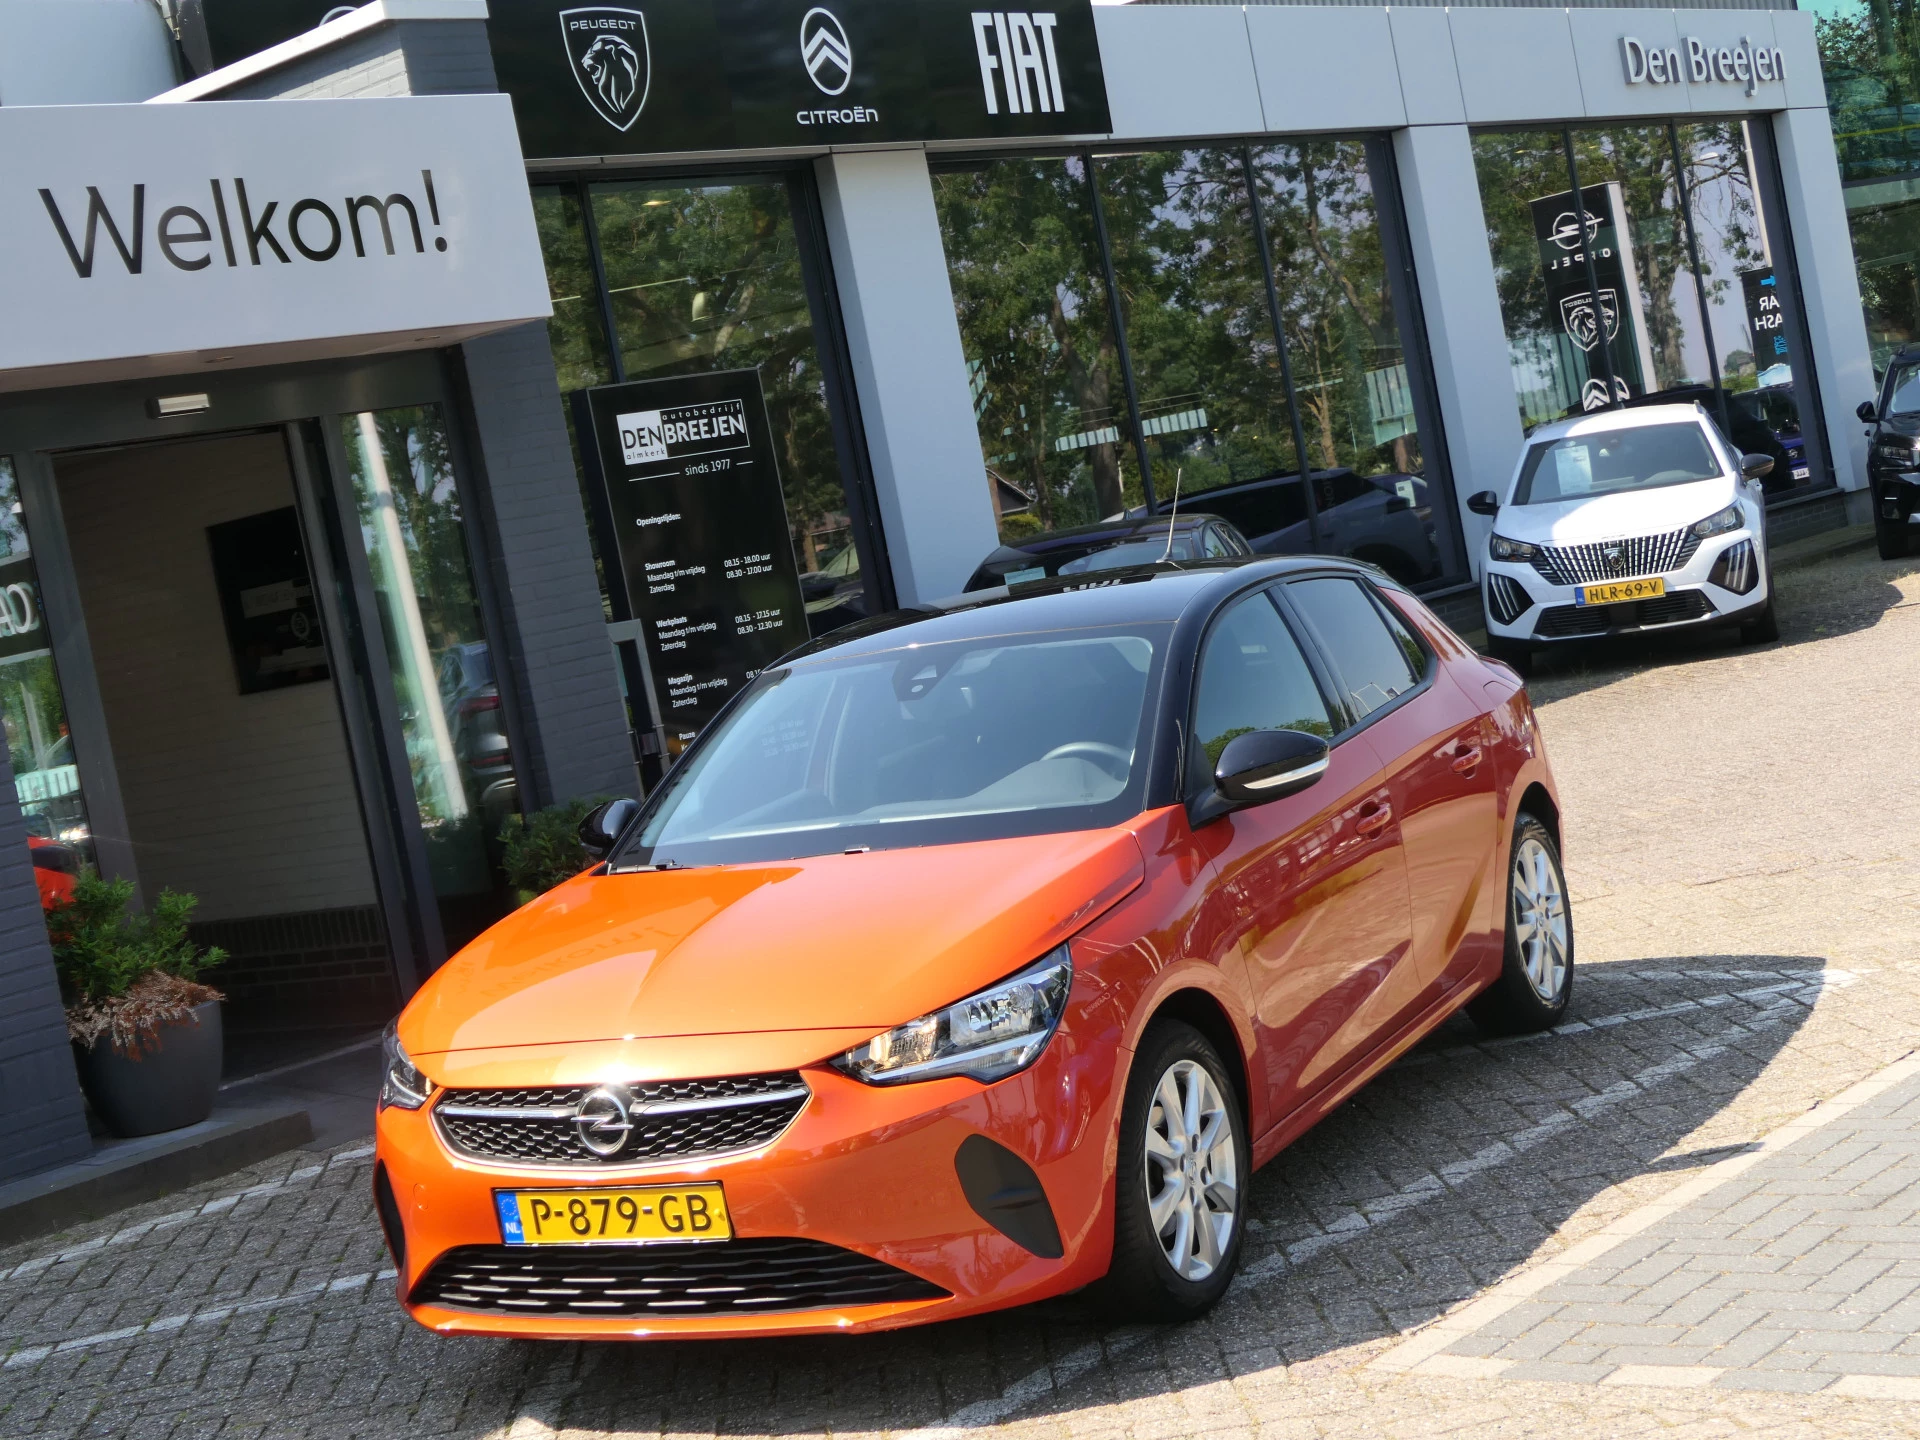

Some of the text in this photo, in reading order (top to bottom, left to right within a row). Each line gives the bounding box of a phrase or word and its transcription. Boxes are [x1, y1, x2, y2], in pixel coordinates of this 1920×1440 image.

[569, 18, 637, 31] PEUGEOT
[970, 12, 1065, 114] FIAT
[1618, 35, 1787, 98] Den Breejen
[37, 169, 449, 279] Welkom!
[662, 402, 741, 420] autobedrijf
[621, 413, 746, 450] DEN BREEJEN
[626, 449, 666, 461] almkerk
[684, 459, 731, 476] sinds 1977
[636, 514, 682, 527] Openingstijden:
[645, 560, 676, 571] Showroom
[647, 572, 674, 582] Maandag
[674, 569, 686, 577] t/m
[685, 565, 706, 576] vrijdag
[724, 558, 740, 568] 08.15
[744, 554, 760, 564] 18.00
[760, 553, 771, 561] uur
[649, 583, 675, 594] Zaterdag
[726, 569, 743, 579] 08.30
[746, 566, 762, 575] 17.00
[762, 564, 773, 572] uur
[1589, 581, 1657, 601] HLR-69-V
[656, 616, 687, 628] Werkplaats
[659, 629, 685, 640] Maandag
[685, 625, 697, 634] t/m
[696, 622, 717, 632] vrijdag
[735, 614, 751, 624] 08.15
[770, 608, 781, 617] uur
[661, 641, 686, 651] Zaterdag
[737, 625, 754, 635] 08.30
[758, 621, 773, 631] 12.30
[773, 619, 783, 628] uur
[667, 673, 693, 686] Magazijn
[670, 686, 697, 696] Maandag
[697, 682, 708, 690] t/m
[708, 678, 728, 689] vrijdag
[672, 697, 698, 708] Zaterdag
[679, 731, 696, 741] Pauze
[530, 1194, 714, 1236] P-879-GB
[505, 1221, 521, 1234] NL
